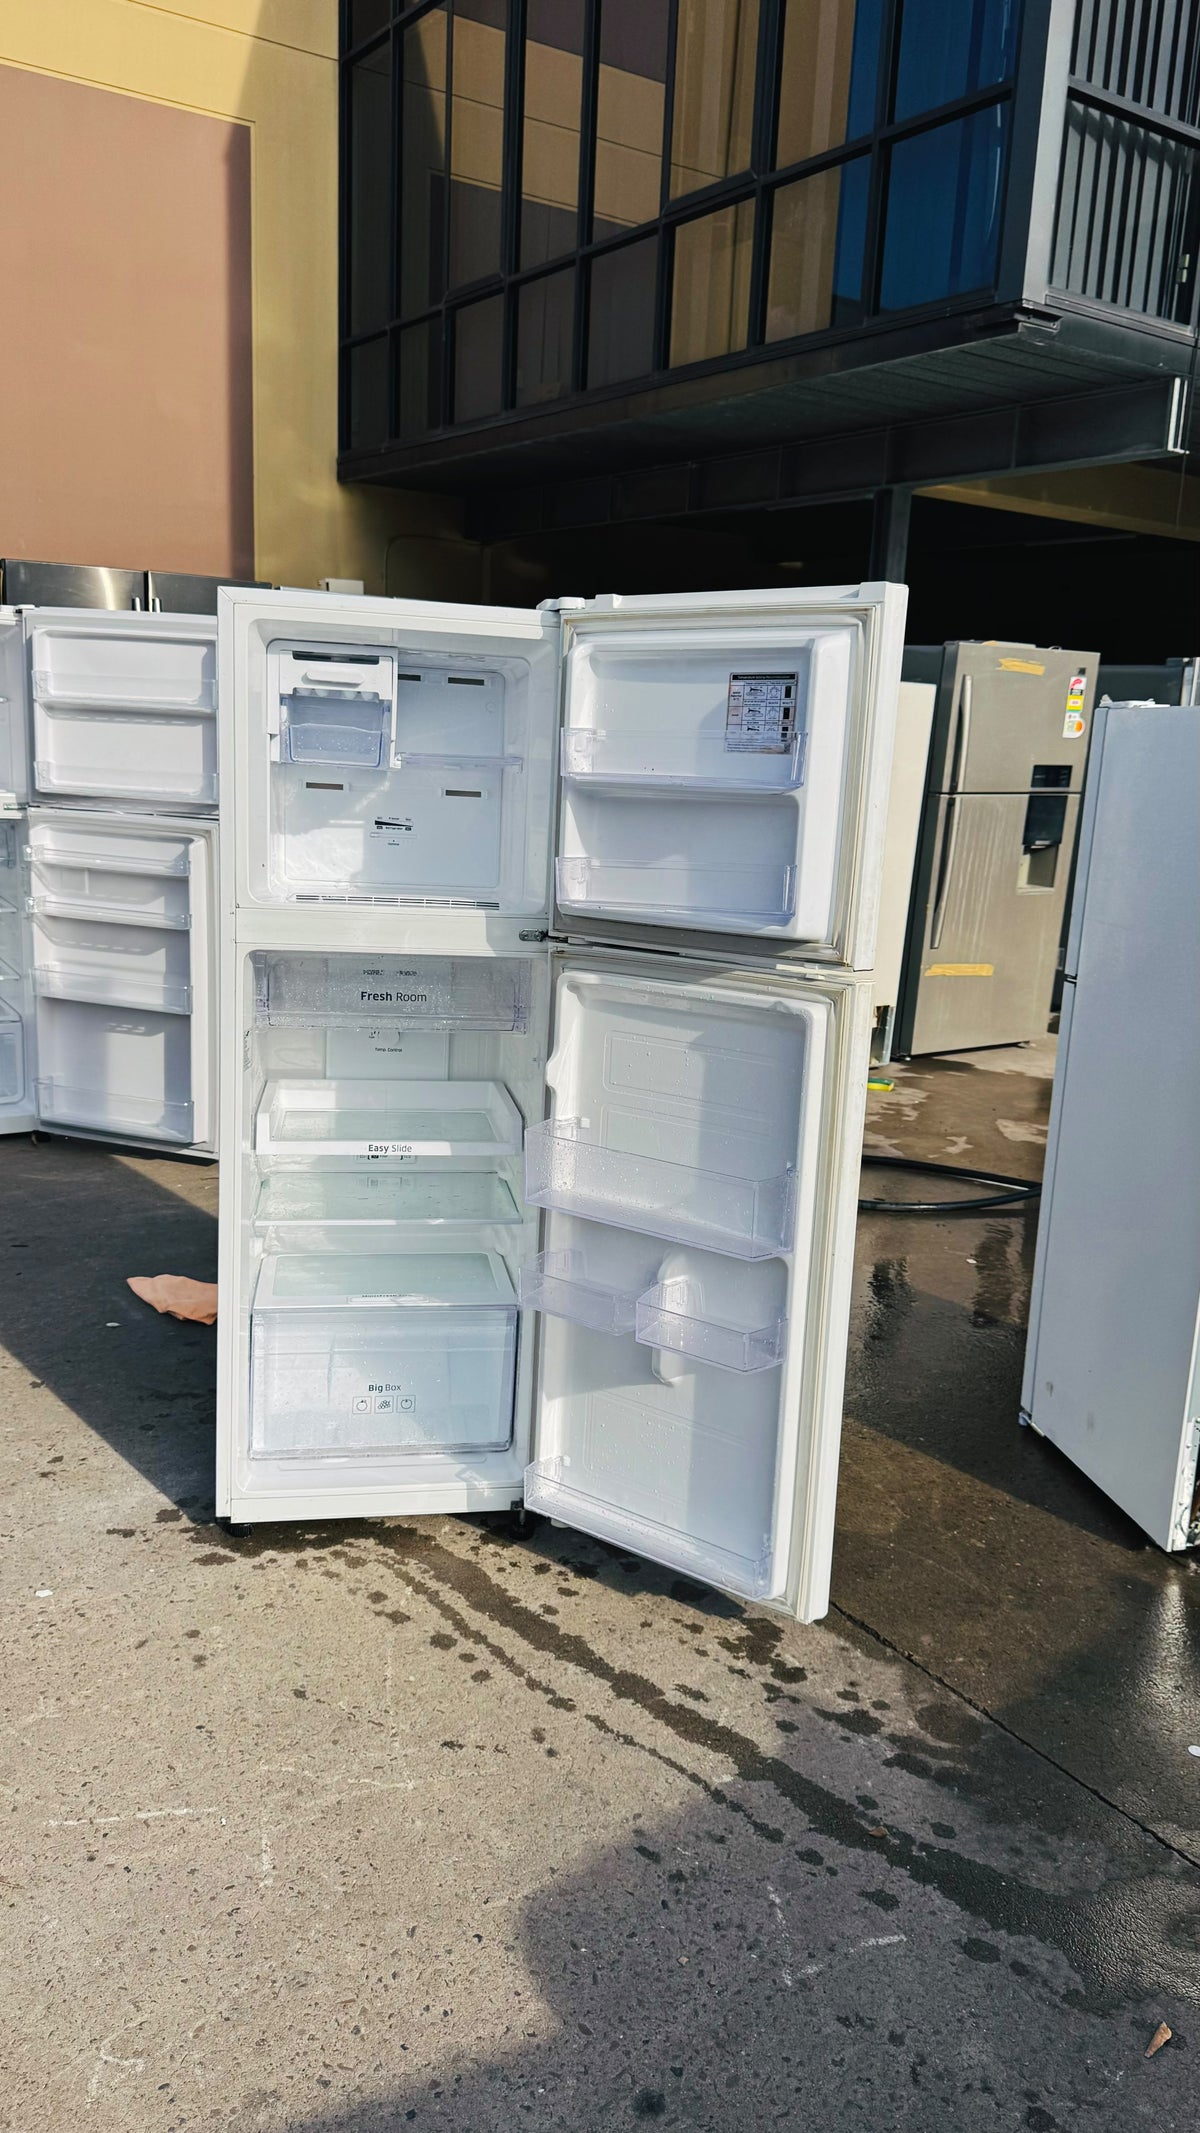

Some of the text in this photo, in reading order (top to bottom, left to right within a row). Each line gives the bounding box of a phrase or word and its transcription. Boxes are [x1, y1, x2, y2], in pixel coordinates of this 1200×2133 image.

[361, 991, 427, 1002] Fresh Room
[368, 1144, 412, 1154] Easy Slide
[368, 1384, 383, 1393] Big
